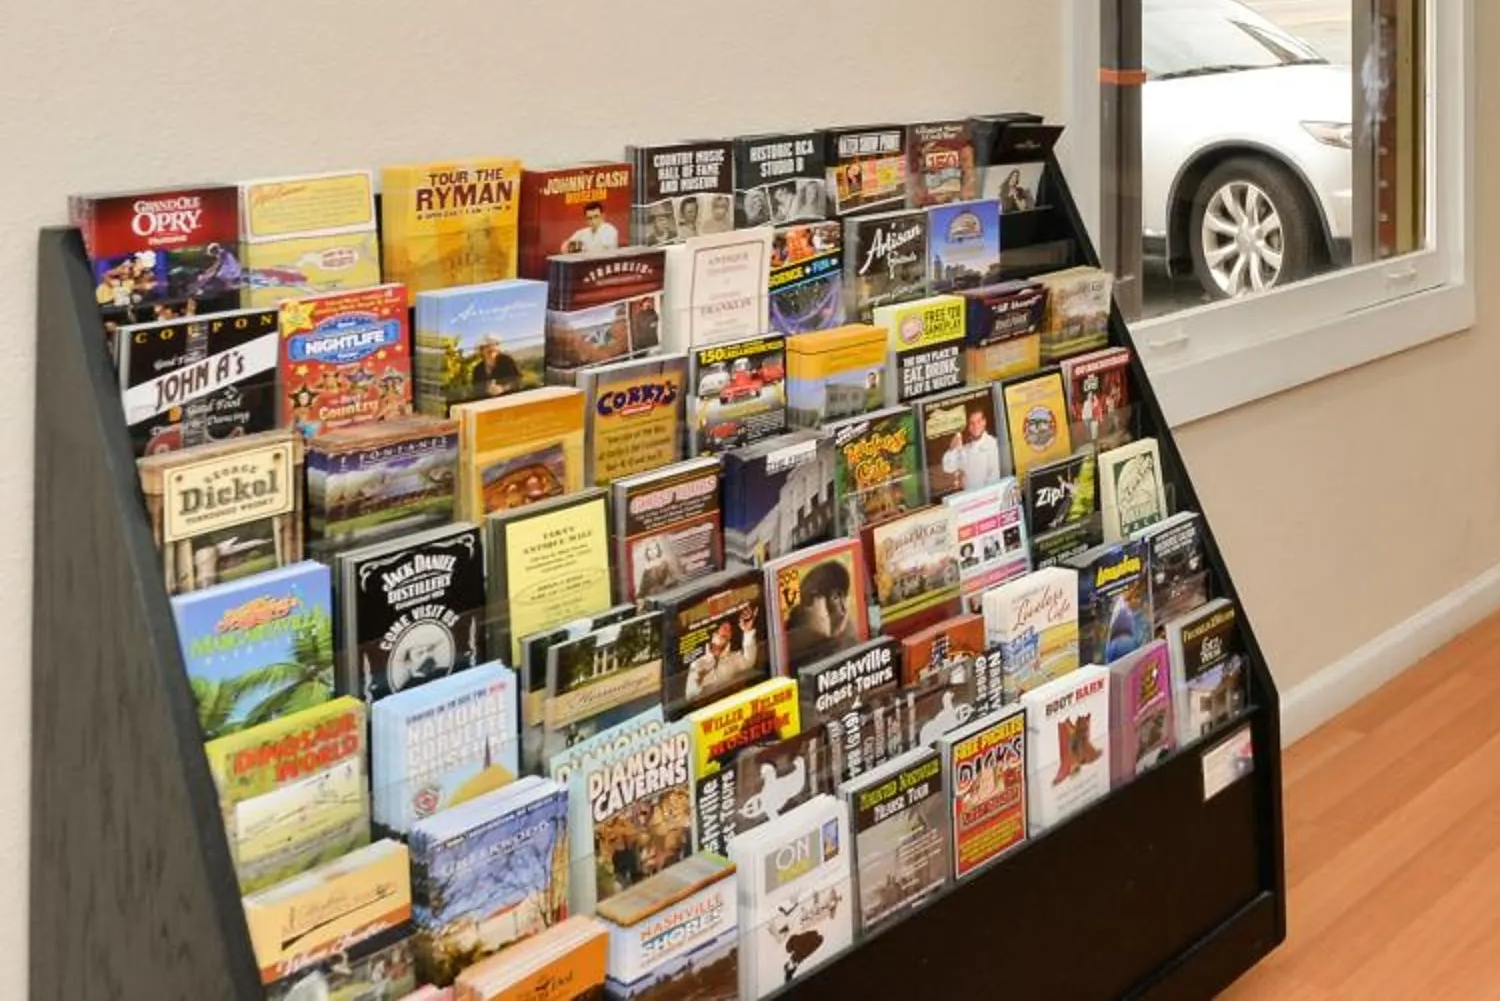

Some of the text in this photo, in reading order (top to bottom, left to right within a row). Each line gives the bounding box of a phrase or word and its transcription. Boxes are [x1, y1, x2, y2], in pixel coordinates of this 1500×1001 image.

[429, 168, 504, 187] TOUR THE
[543, 170, 629, 196] JOHNNY CASH
[416, 180, 513, 212] RYMAN
[132, 210, 203, 237] OPRY
[305, 330, 385, 355] NIGHTLIFE
[155, 365, 209, 411] JOHN
[179, 470, 279, 516] Dickel
[382, 562, 415, 591] JACK
[387, 576, 451, 604] DISTILLERY
[380, 615, 412, 651] COME
[411, 603, 445, 621] VISIT
[818, 647, 892, 693] Nashville
[855, 666, 893, 692] Tours
[587, 731, 691, 802] DIAMOND
[593, 759, 689, 823] CAVERNS
